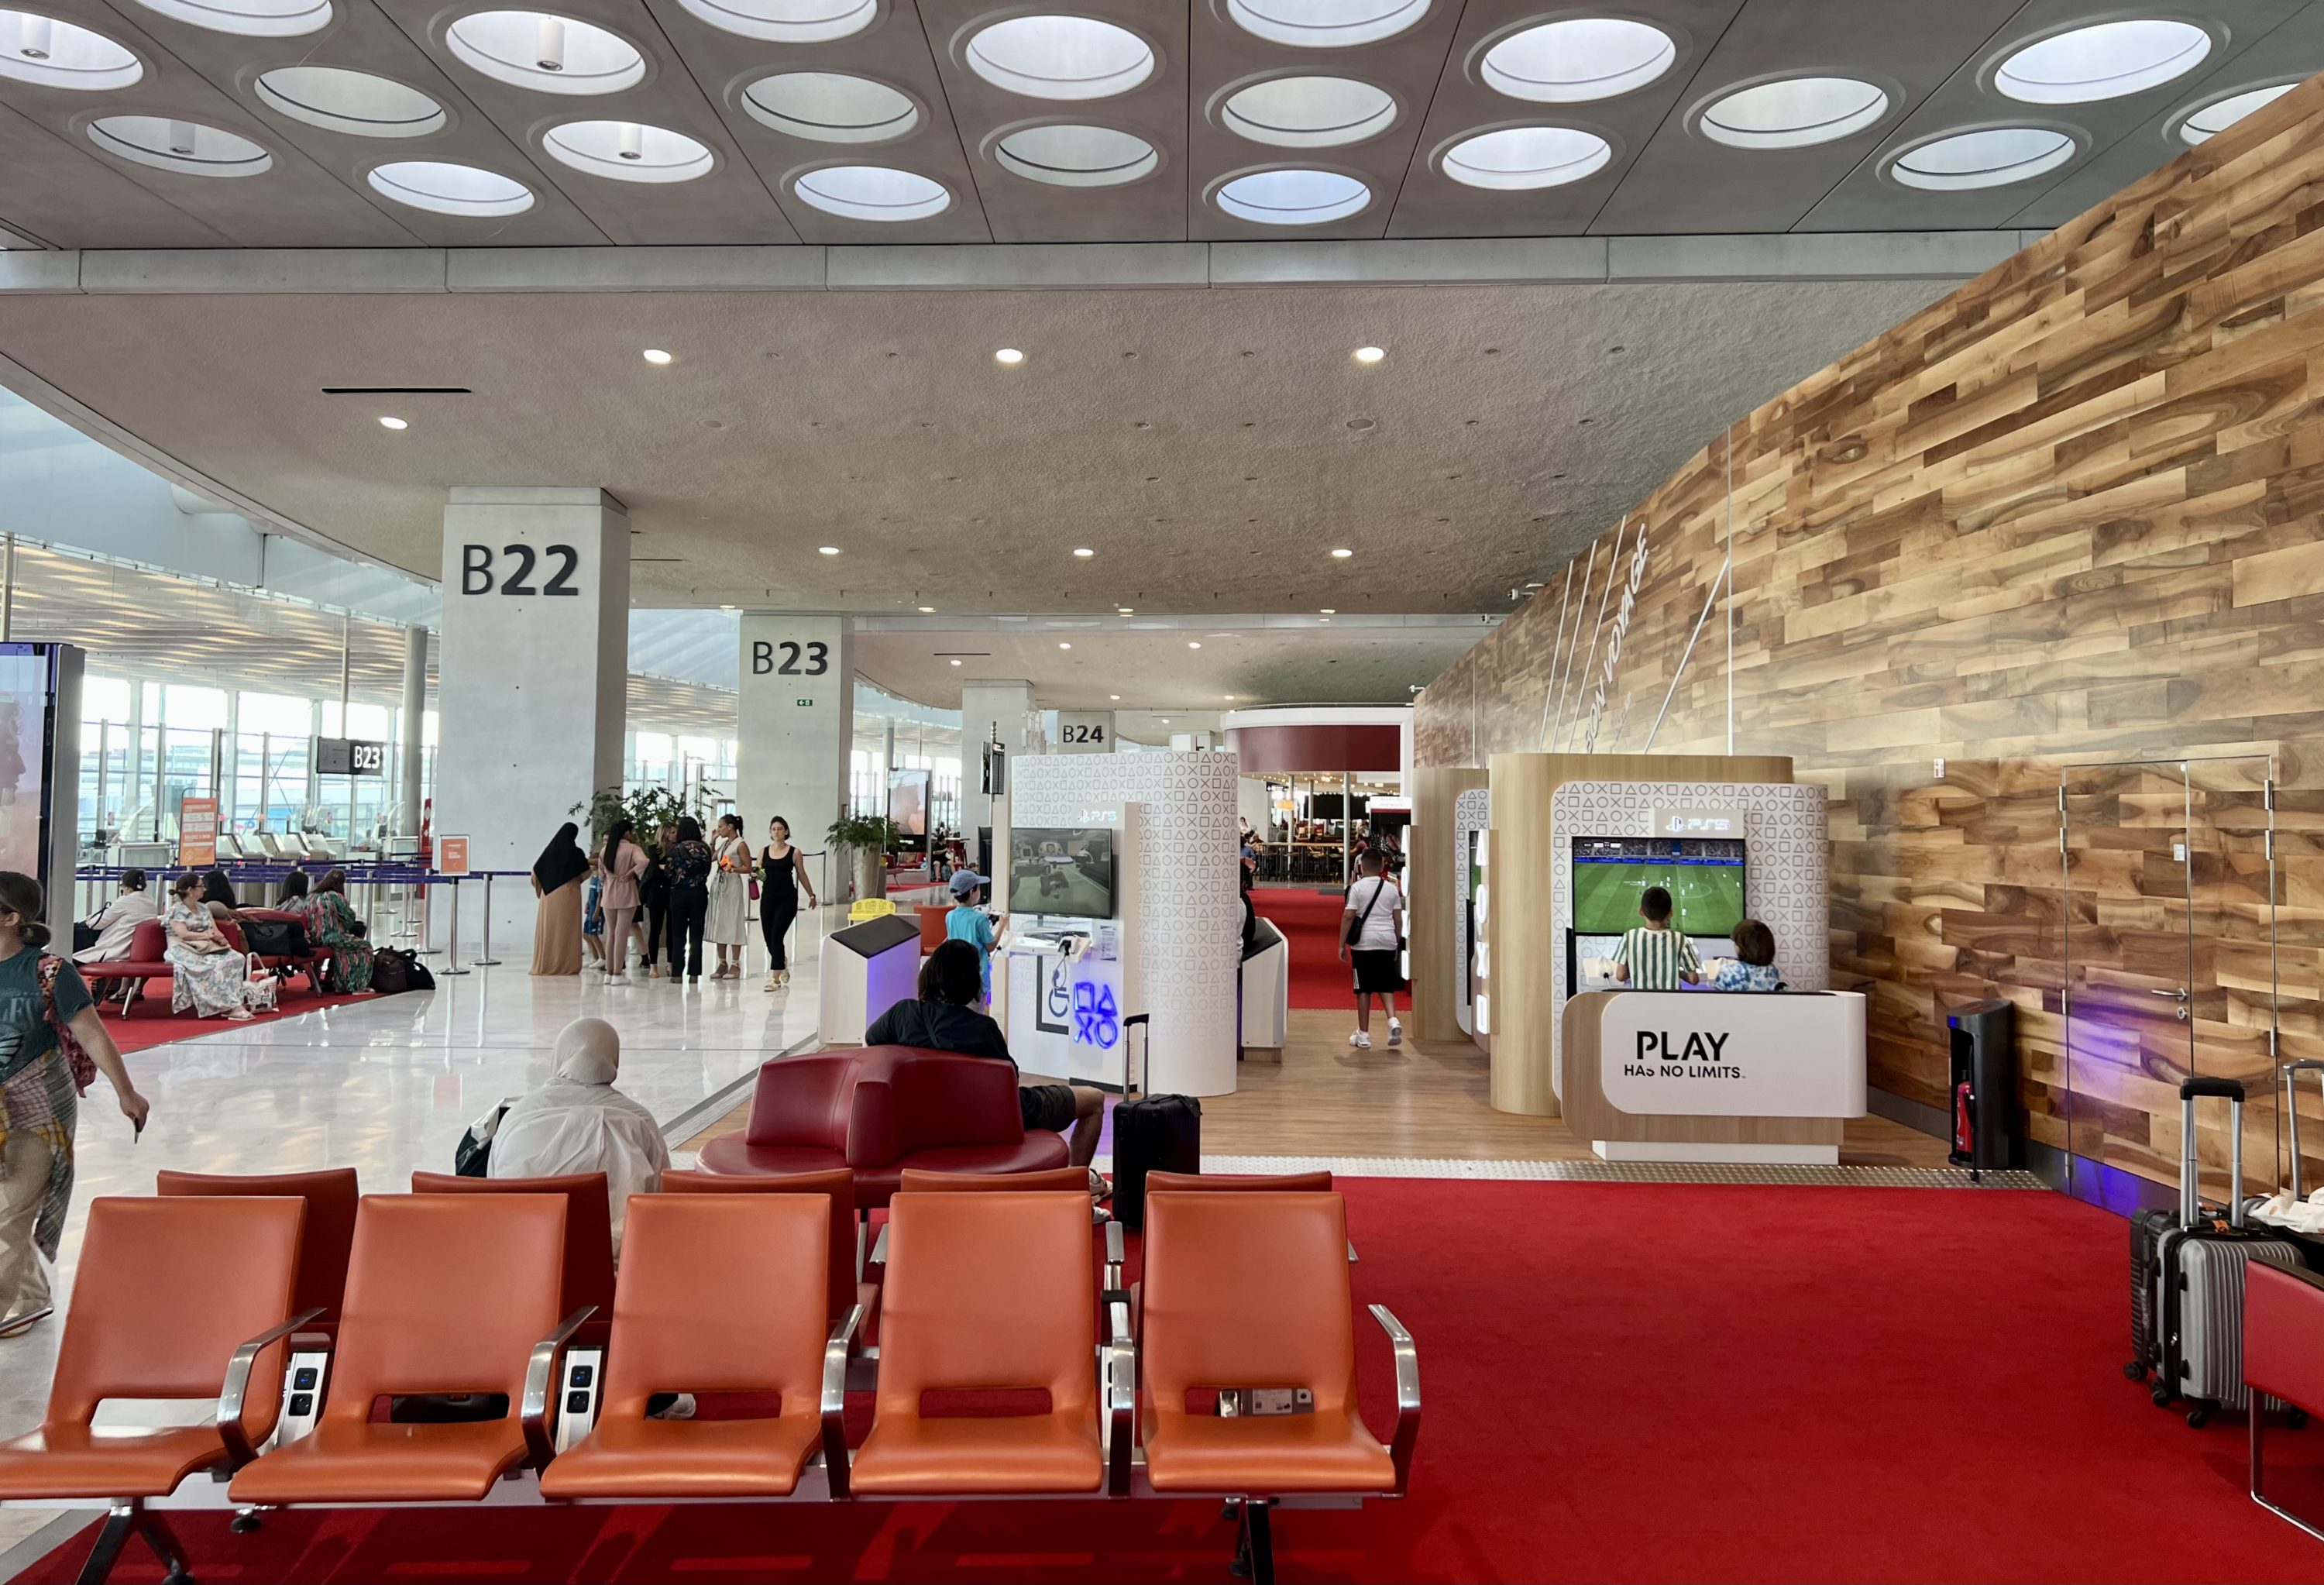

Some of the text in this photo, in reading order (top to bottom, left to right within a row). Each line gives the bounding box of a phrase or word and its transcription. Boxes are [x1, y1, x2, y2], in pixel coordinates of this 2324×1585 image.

[462, 544, 579, 596] B22
[1603, 522, 1648, 685] VOYAGE
[752, 641, 828, 676] B23
[1063, 725, 1104, 743] B24
[354, 745, 380, 769] B23
[1091, 810, 1116, 822] PS5
[1687, 817, 1731, 831] PS5
[1636, 1030, 1730, 1061] PLAY
[1624, 1064, 1655, 1077] HAS
[1660, 1065, 1683, 1078] NO
